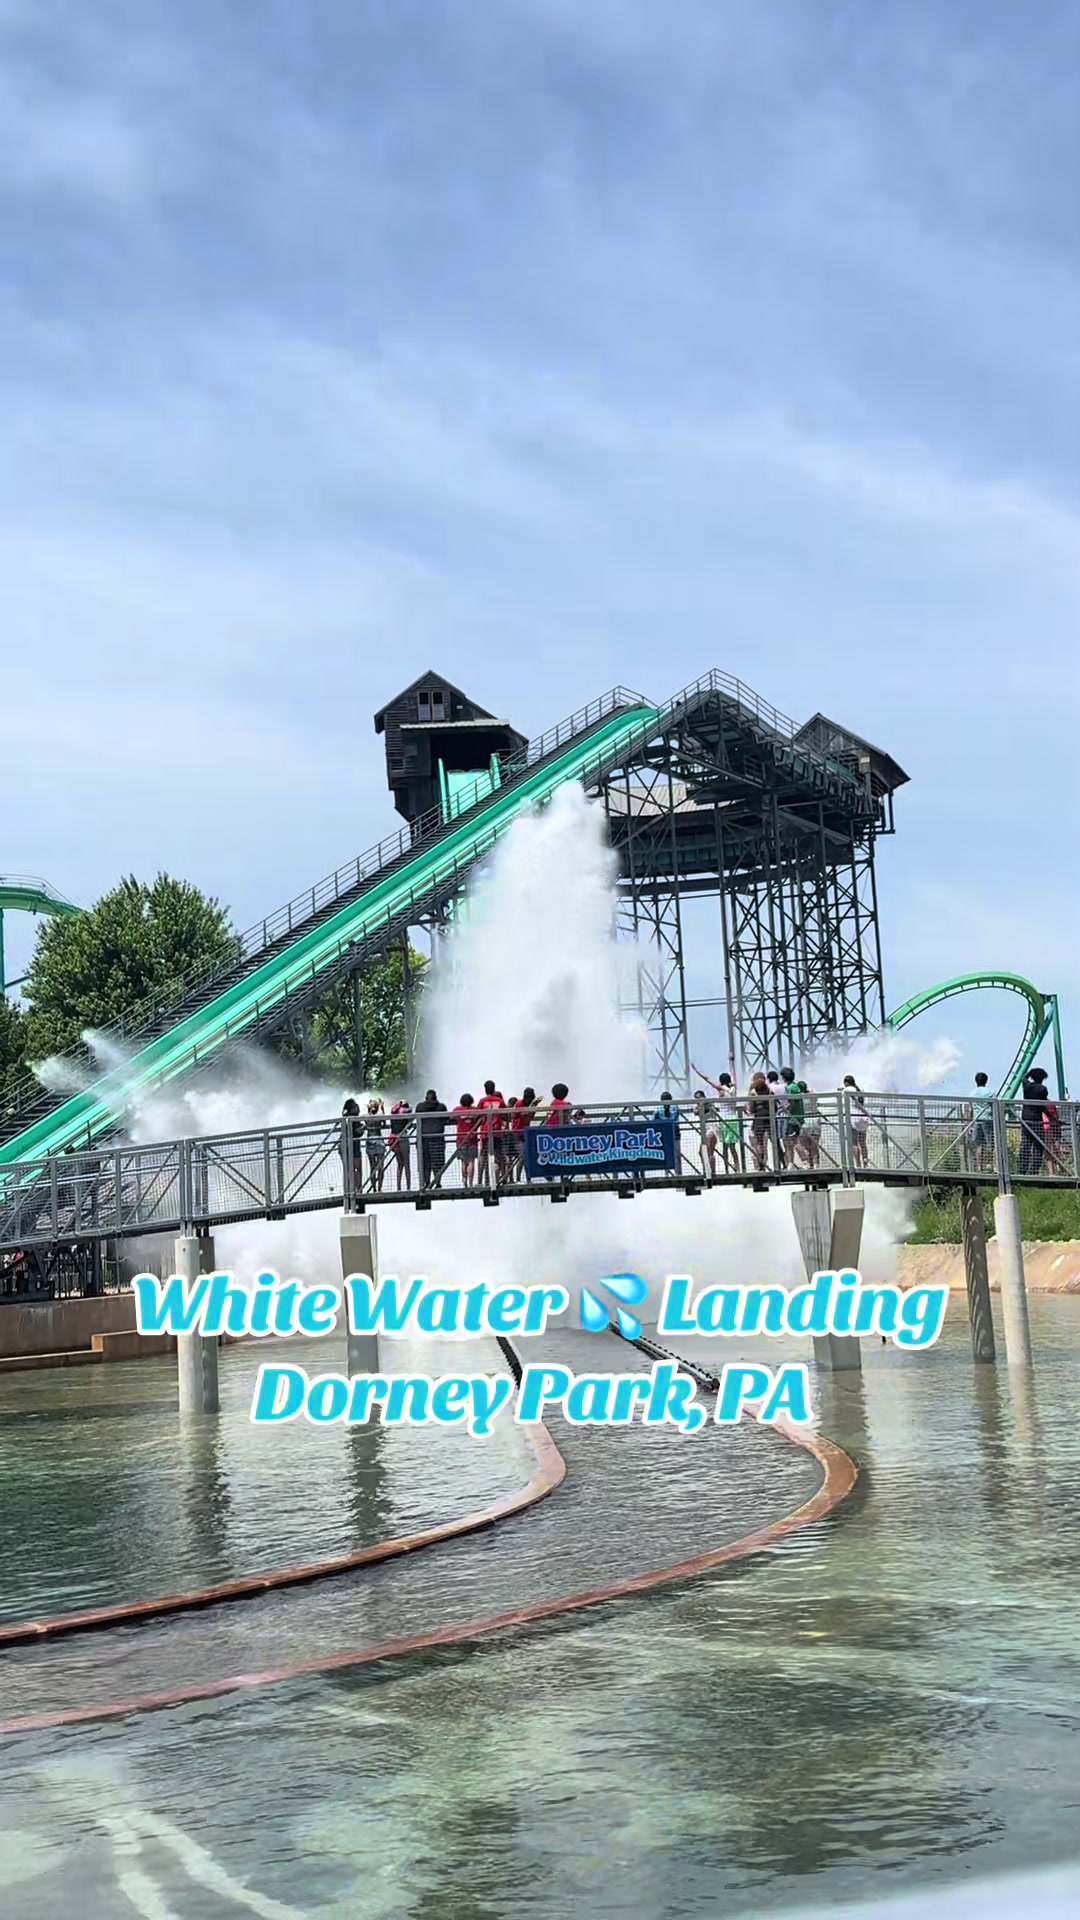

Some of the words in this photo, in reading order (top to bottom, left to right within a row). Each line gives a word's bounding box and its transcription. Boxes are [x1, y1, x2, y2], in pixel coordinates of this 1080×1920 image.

[537, 1134, 613, 1152] Dorney
[615, 1128, 662, 1147] Park
[549, 1152, 609, 1165] Wildwater
[609, 1147, 664, 1160] Kingdom
